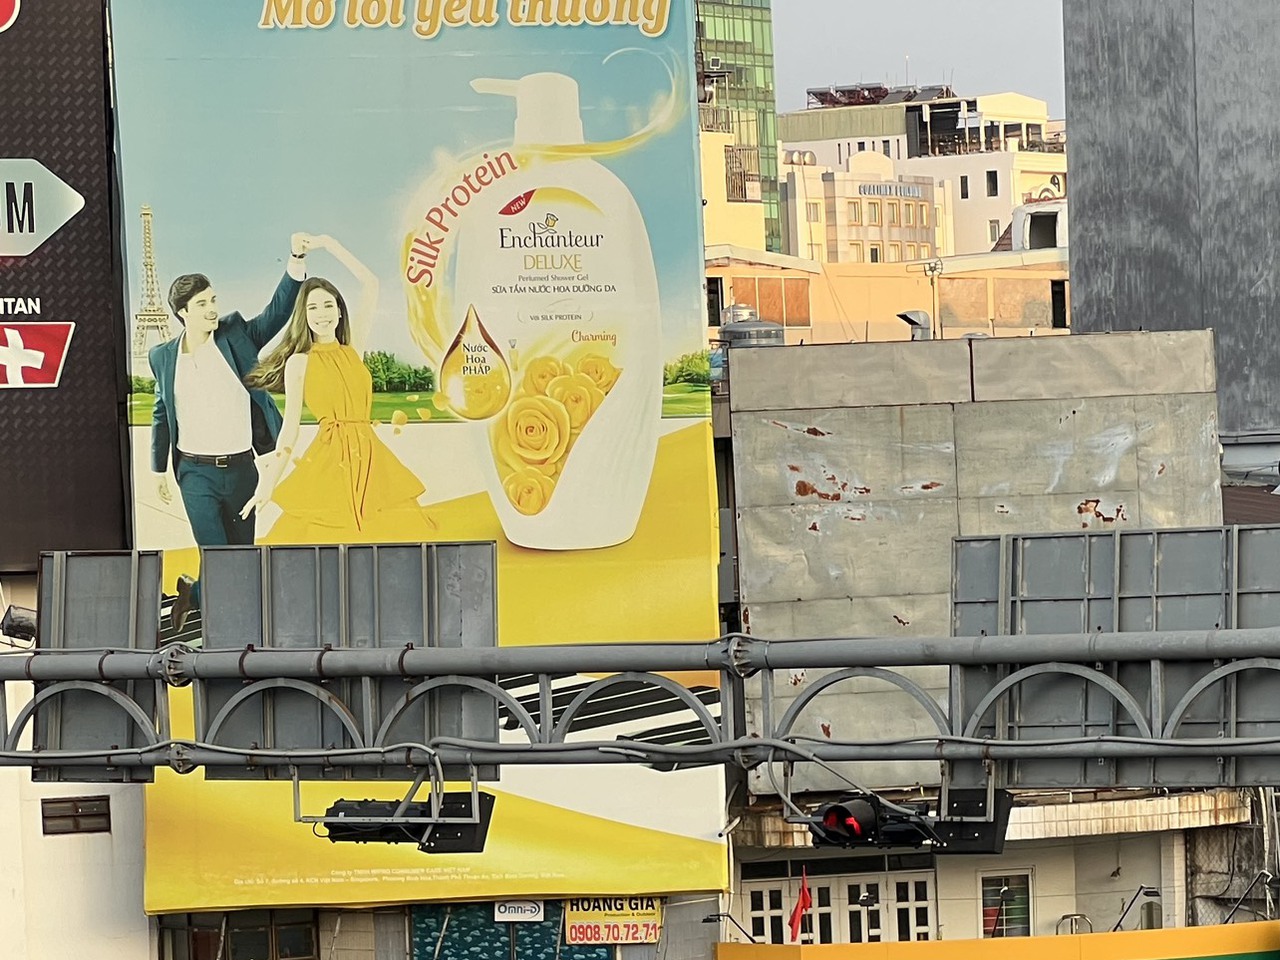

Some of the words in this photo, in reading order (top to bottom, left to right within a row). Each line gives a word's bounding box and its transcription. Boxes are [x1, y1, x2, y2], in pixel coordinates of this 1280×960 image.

[425, 151, 518, 233] Protein
[509, 197, 527, 213] NEW
[498, 221, 604, 249] Enchanteur
[406, 231, 445, 288] Silk
[524, 254, 583, 272] DELUXE
[551, 274, 575, 282] Shower
[553, 285, 571, 293] HOA
[604, 284, 617, 292] DA
[571, 329, 617, 346] Charming
[462, 343, 488, 353] Nước
[465, 354, 487, 364] Hoa
[462, 364, 491, 375] PHÁP
